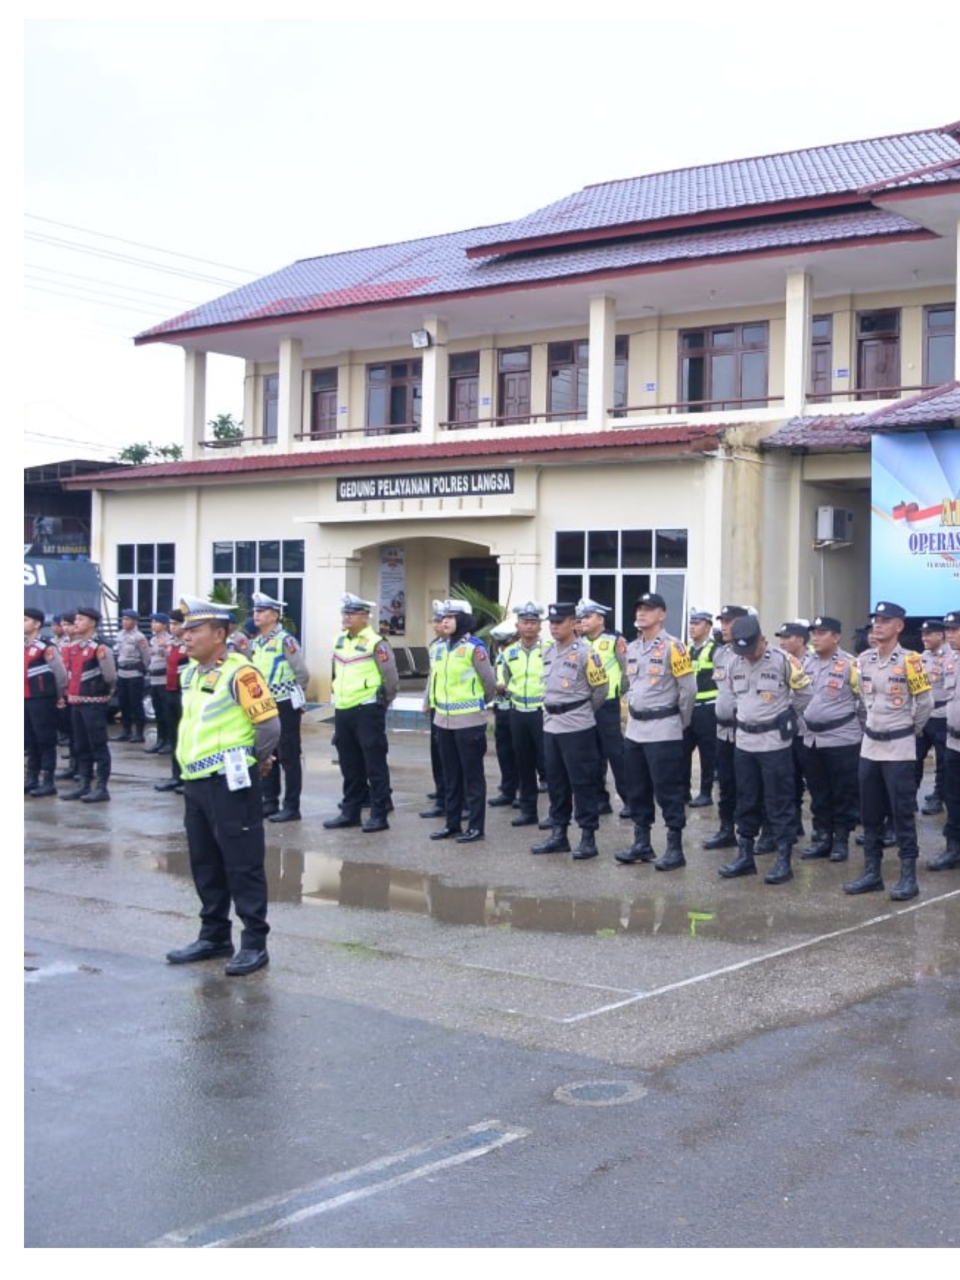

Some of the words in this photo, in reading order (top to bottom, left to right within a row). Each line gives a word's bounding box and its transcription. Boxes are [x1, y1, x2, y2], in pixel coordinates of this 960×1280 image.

[340, 480, 376, 498] GEDUNG
[378, 477, 430, 496] PELAYANAN
[432, 474, 469, 494] POLRES
[471, 472, 511, 492] LANGSA
